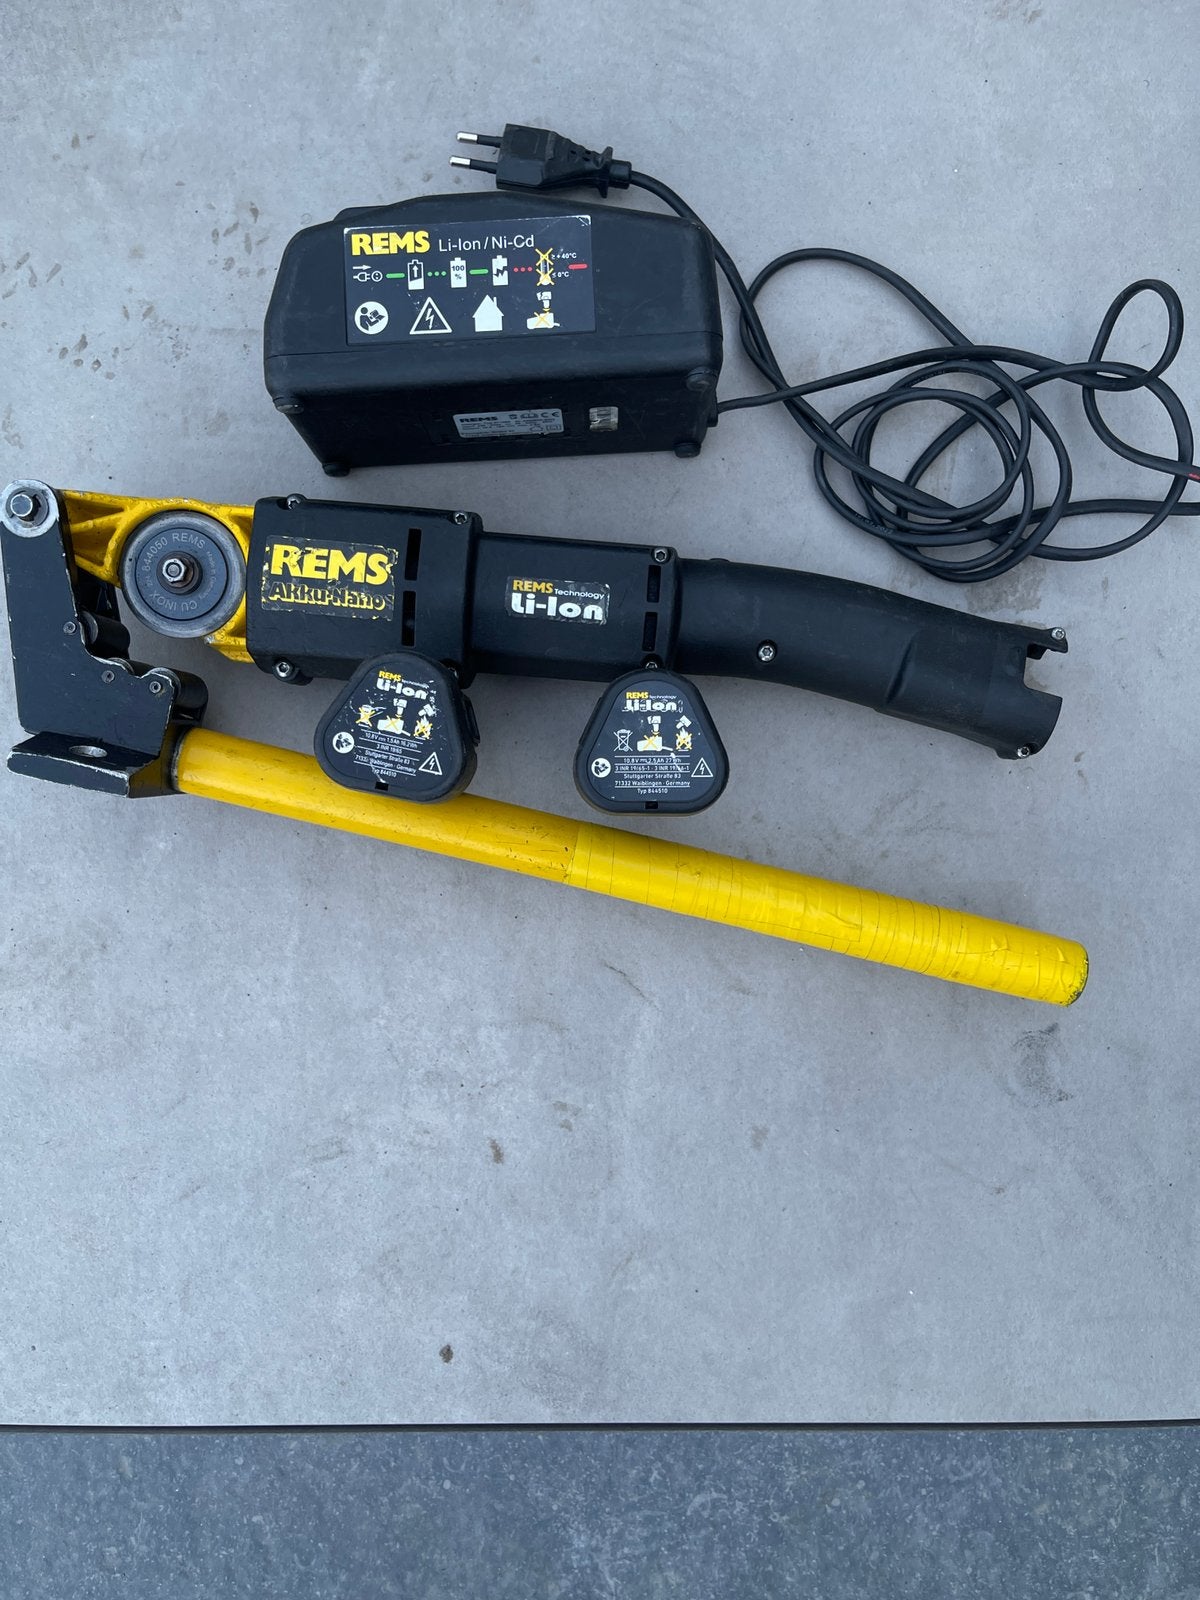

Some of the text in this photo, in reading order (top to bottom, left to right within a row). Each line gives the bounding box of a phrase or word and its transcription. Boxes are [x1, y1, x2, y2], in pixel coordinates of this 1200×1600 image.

[351, 230, 431, 256] REMS
[438, 237, 482, 252] Li-Ion
[491, 234, 535, 249] Ni-Cd
[142, 532, 206, 572] 844050 REMS
[268, 544, 389, 611] REMS Akku-Nano
[512, 579, 605, 600] REMS Technology
[149, 590, 177, 612] INOX
[511, 592, 603, 620] Li-Ion
[378, 670, 402, 682] REMS
[376, 678, 428, 700] Li-Ion
[626, 691, 649, 699] REMS
[625, 699, 677, 711] Li-Ion
[396, 764, 417, 774] Germany
